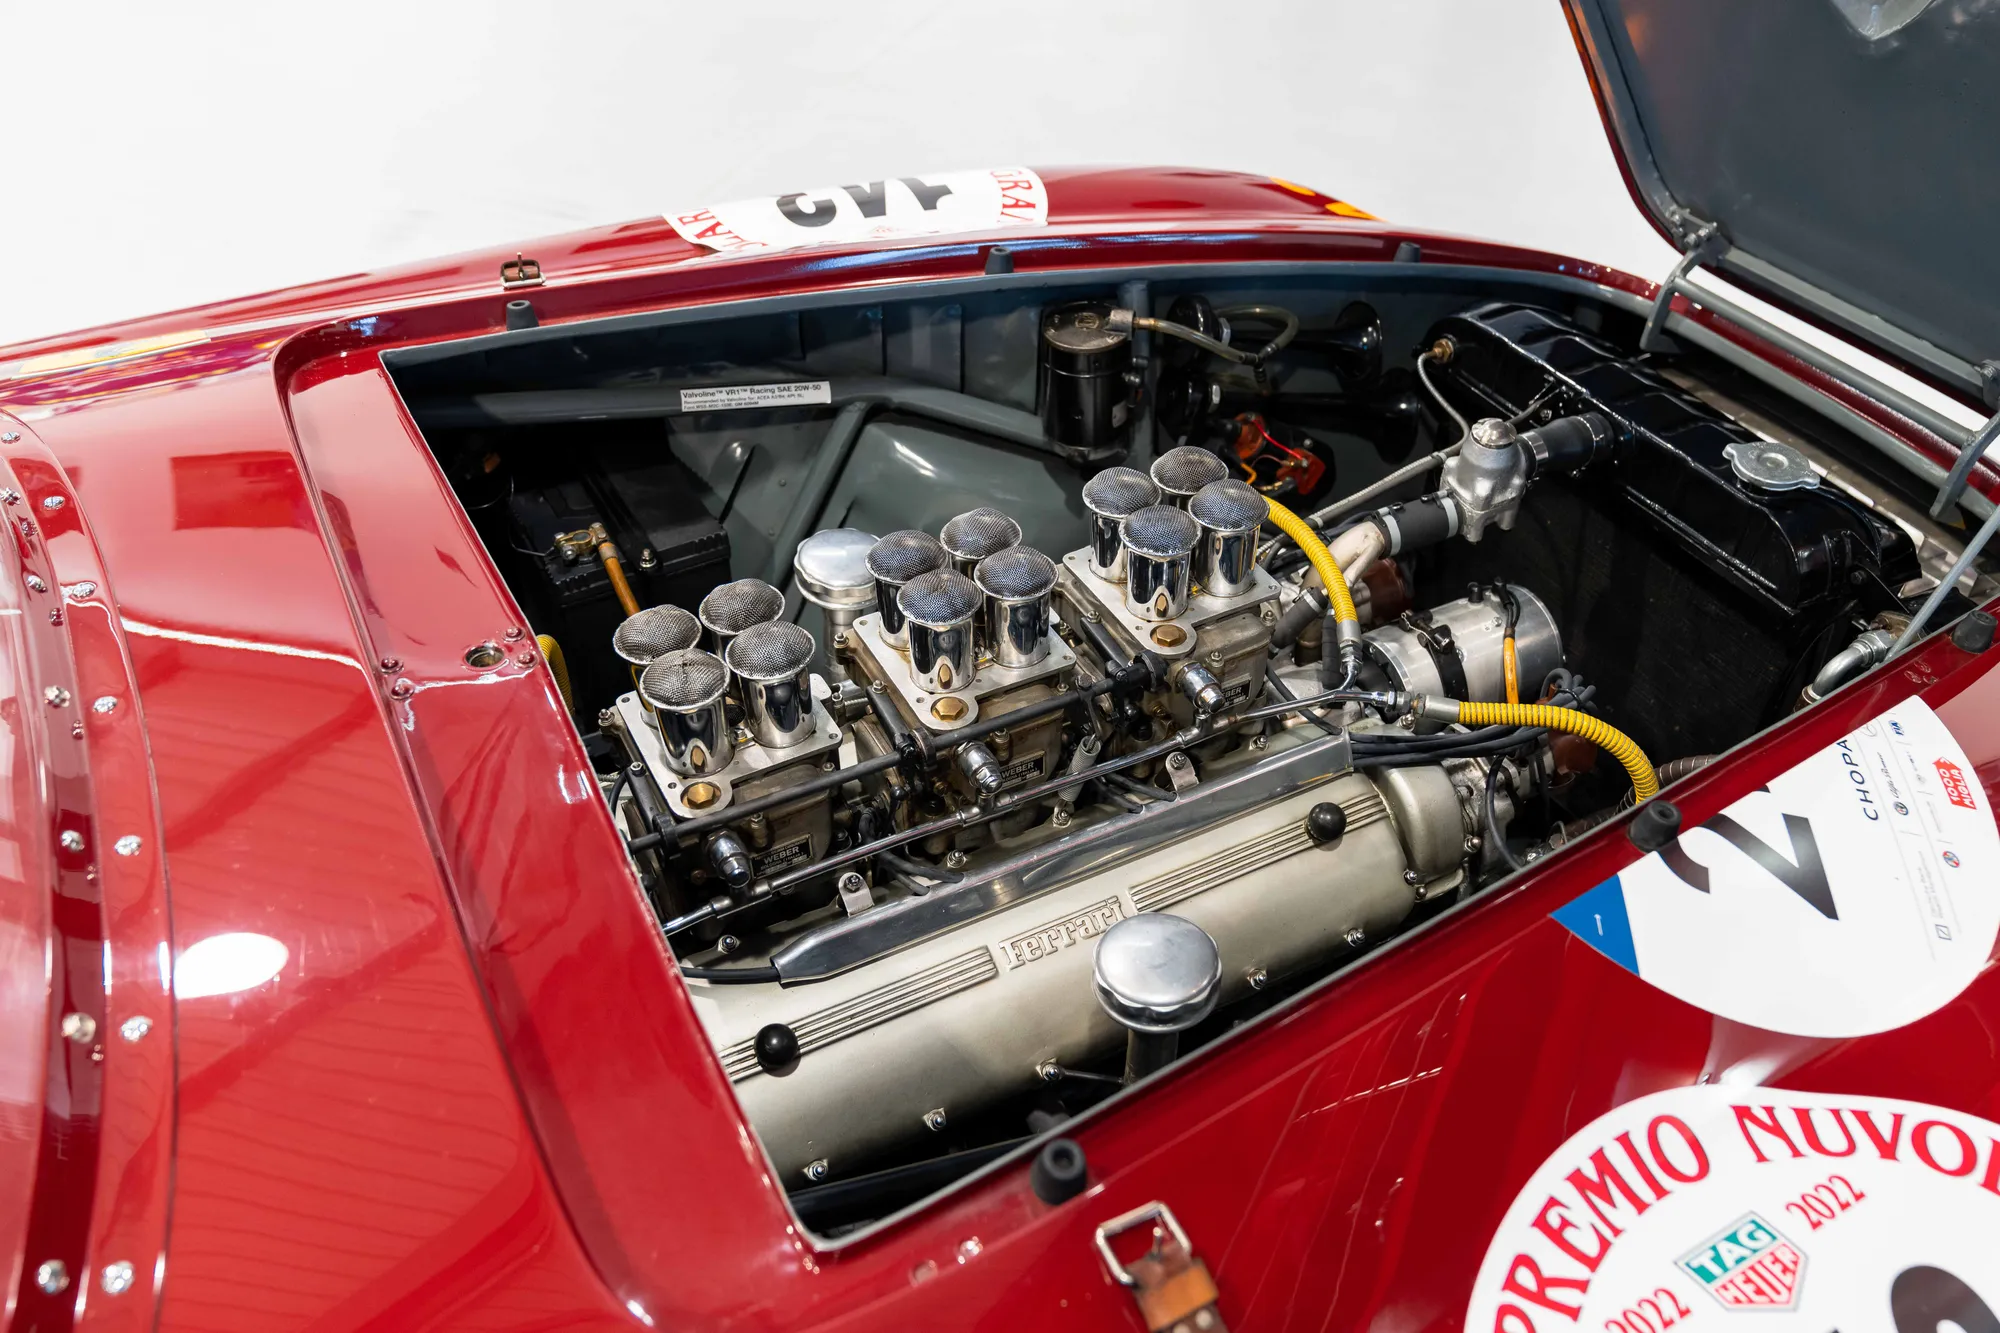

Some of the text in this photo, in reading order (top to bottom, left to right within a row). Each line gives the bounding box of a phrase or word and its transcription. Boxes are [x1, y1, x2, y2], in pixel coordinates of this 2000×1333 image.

[1001, 762, 1035, 779] WEBER
[1939, 768, 1958, 802] 1000
[1950, 769, 1976, 808] MIGLIA
[763, 846, 800, 865] WEBER
[1000, 895, 1127, 972] Ferrari
[1786, 1174, 1866, 1231] 2022
[1687, 1222, 1776, 1283] TAG
[1715, 1243, 1800, 1304] HEUER
